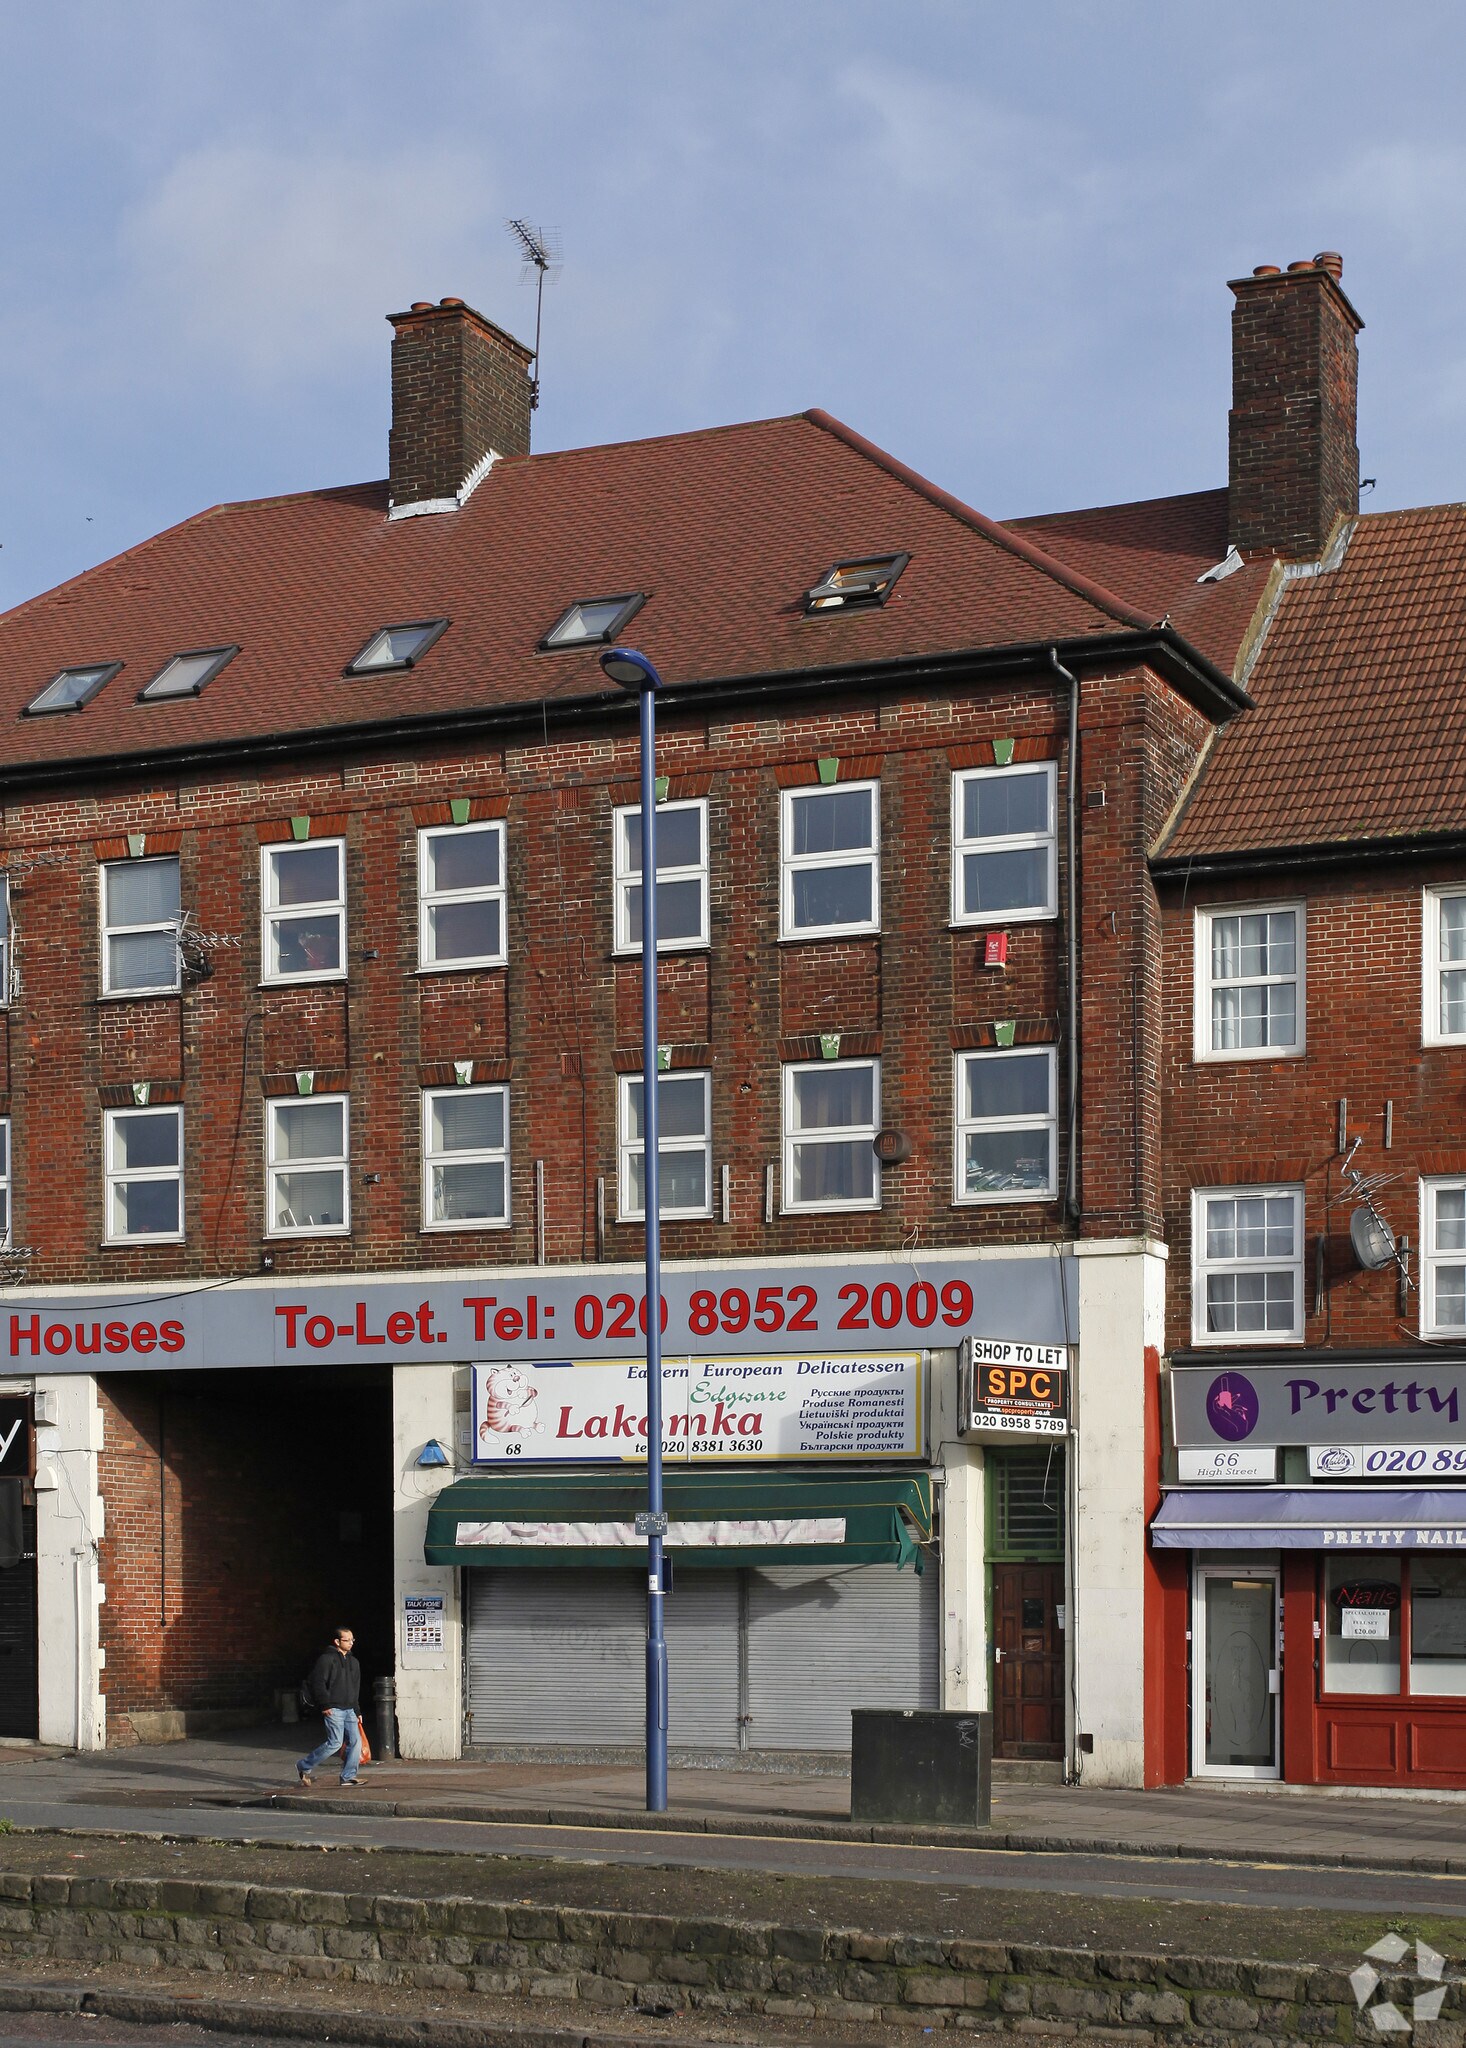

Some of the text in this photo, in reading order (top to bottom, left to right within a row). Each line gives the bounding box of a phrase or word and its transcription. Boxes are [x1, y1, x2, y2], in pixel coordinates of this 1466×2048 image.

[9, 1314, 186, 1357] Houses
[274, 1300, 448, 1349] To-Let.
[462, 1296, 556, 1342] Tel:
[687, 1286, 819, 1337] 8952
[836, 1279, 975, 1331] 2009
[974, 1342, 1062, 1365] SHOP TO LET
[627, 1361, 905, 1379] Eaern European Delicatessen
[988, 1368, 1051, 1399] SPC
[690, 1381, 787, 1409] Edgware
[853, 1389, 904, 1398] продукты
[802, 1399, 845, 1408] Produse
[1284, 1379, 1459, 1424] Pretty
[799, 1408, 904, 1419] Lietuviški produktai
[856, 1421, 904, 1430] продукти
[974, 1414, 1064, 1432] 020 8958 5789
[816, 1430, 905, 1440] Polskie produkty
[505, 1443, 522, 1455] 68
[661, 1441, 685, 1453] 020
[691, 1440, 724, 1452] 8381
[728, 1440, 763, 1452] 3630
[856, 1442, 904, 1451] продукти
[1214, 1452, 1240, 1467] 66
[1366, 1450, 1427, 1471] 020
[1432, 1449, 1466, 1471] 89
[1197, 1468, 1258, 1477] High Street
[1323, 1530, 1466, 1544] PRETTY NAIL
[1336, 1587, 1397, 1605] Nails
